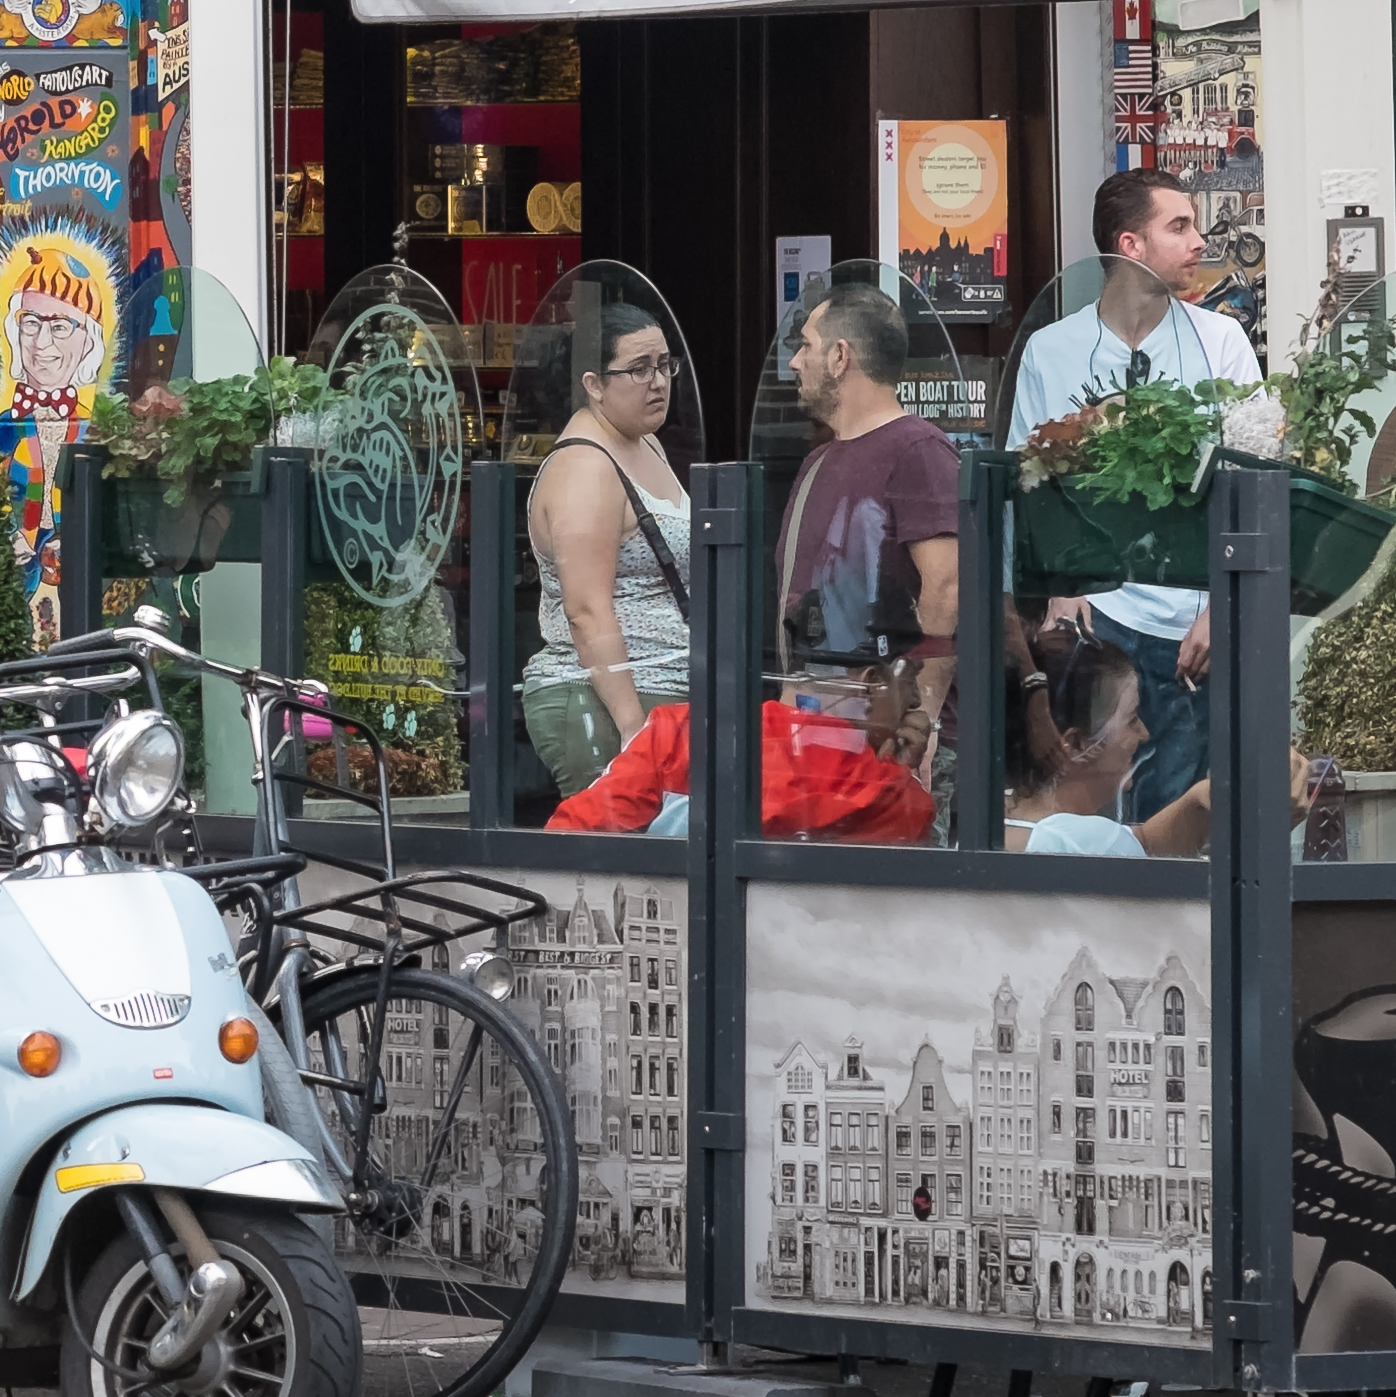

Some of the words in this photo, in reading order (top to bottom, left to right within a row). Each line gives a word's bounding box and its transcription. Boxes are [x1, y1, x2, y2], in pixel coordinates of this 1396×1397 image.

[41, 100, 117, 161] KANGAROO
[14, 161, 121, 202] THORNTON
[920, 381, 950, 402] BOAT
[952, 380, 986, 402] TOUR
[948, 403, 986, 418] HISTORY
[538, 951, 559, 963] BEST
[574, 951, 612, 964] BIGGEST
[387, 1019, 420, 1033] HOTEL
[1110, 1069, 1150, 1085] HOTEL
